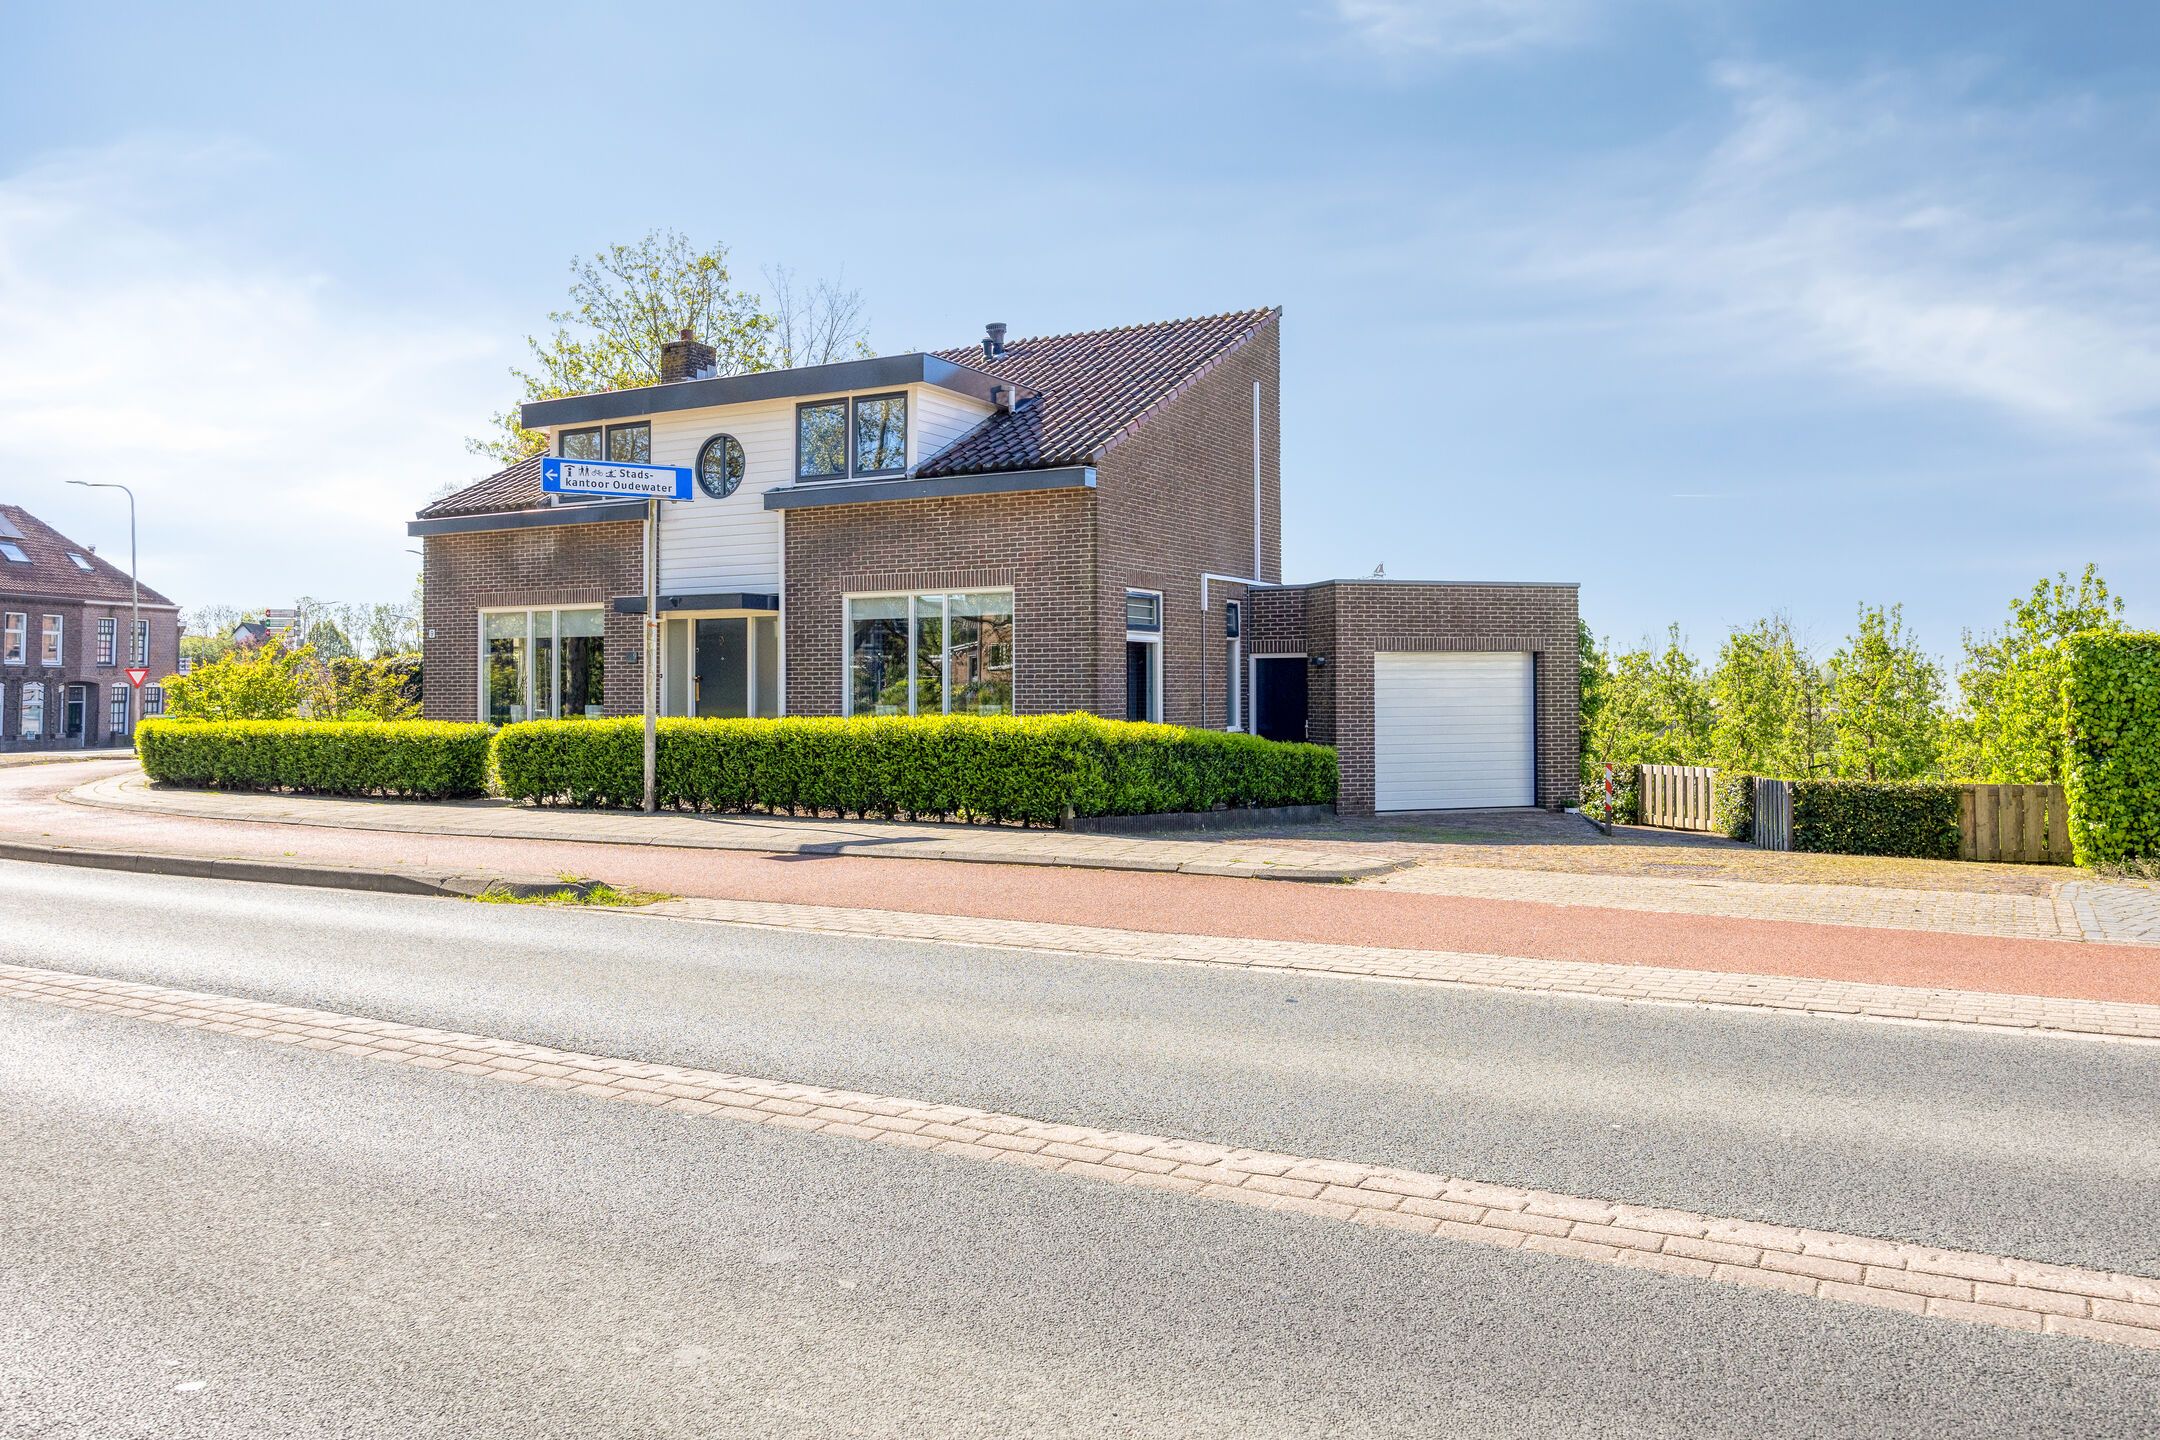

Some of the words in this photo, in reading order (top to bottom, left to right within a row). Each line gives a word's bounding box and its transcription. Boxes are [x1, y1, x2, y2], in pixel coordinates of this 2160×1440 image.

[620, 469, 653, 479] Stads-
[565, 478, 610, 489] kantoor
[613, 481, 672, 492] Oudewater
